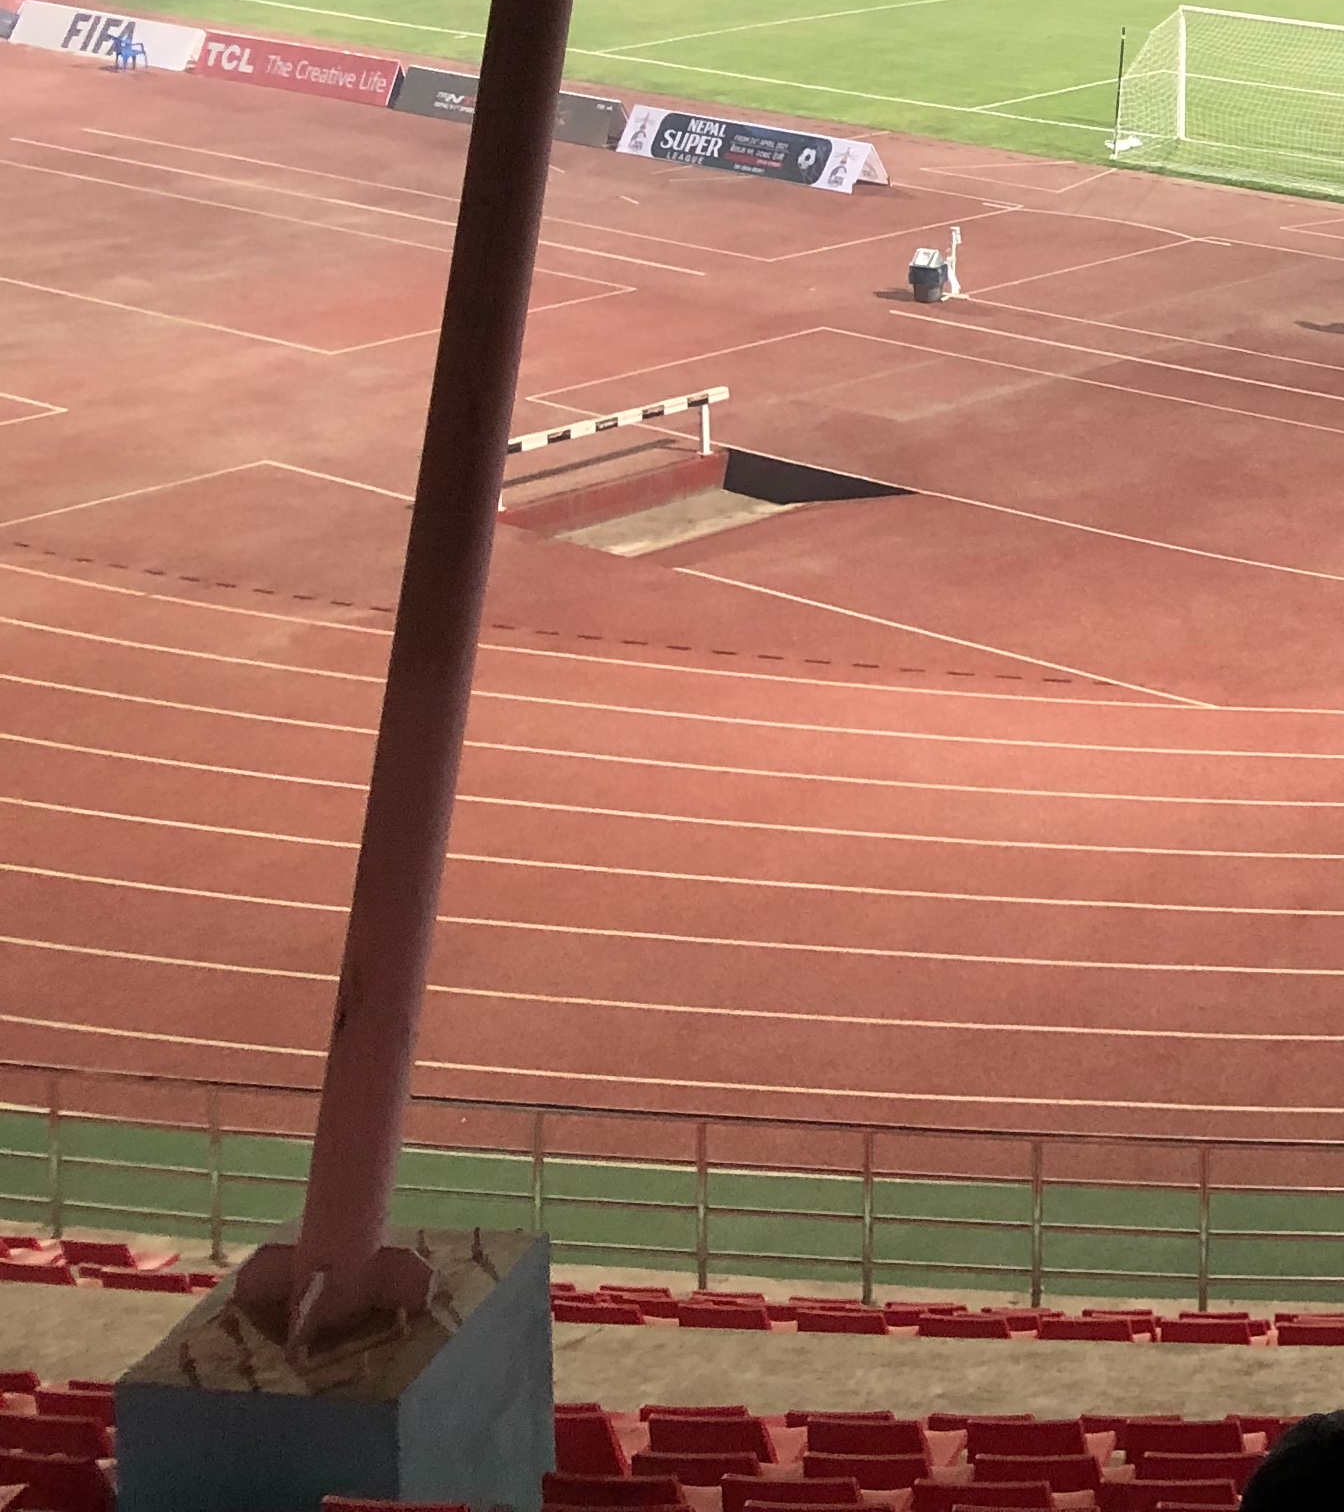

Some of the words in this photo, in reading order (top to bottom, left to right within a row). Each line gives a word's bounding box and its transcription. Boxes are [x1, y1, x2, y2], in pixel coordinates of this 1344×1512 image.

[206, 42, 254, 74] TCL
[264, 54, 293, 76] The
[295, 60, 357, 88] Creative
[359, 69, 388, 94] Life
[687, 118, 727, 138] NEPAL
[659, 129, 723, 158] SUPER
[666, 151, 705, 166] LEAGUE
